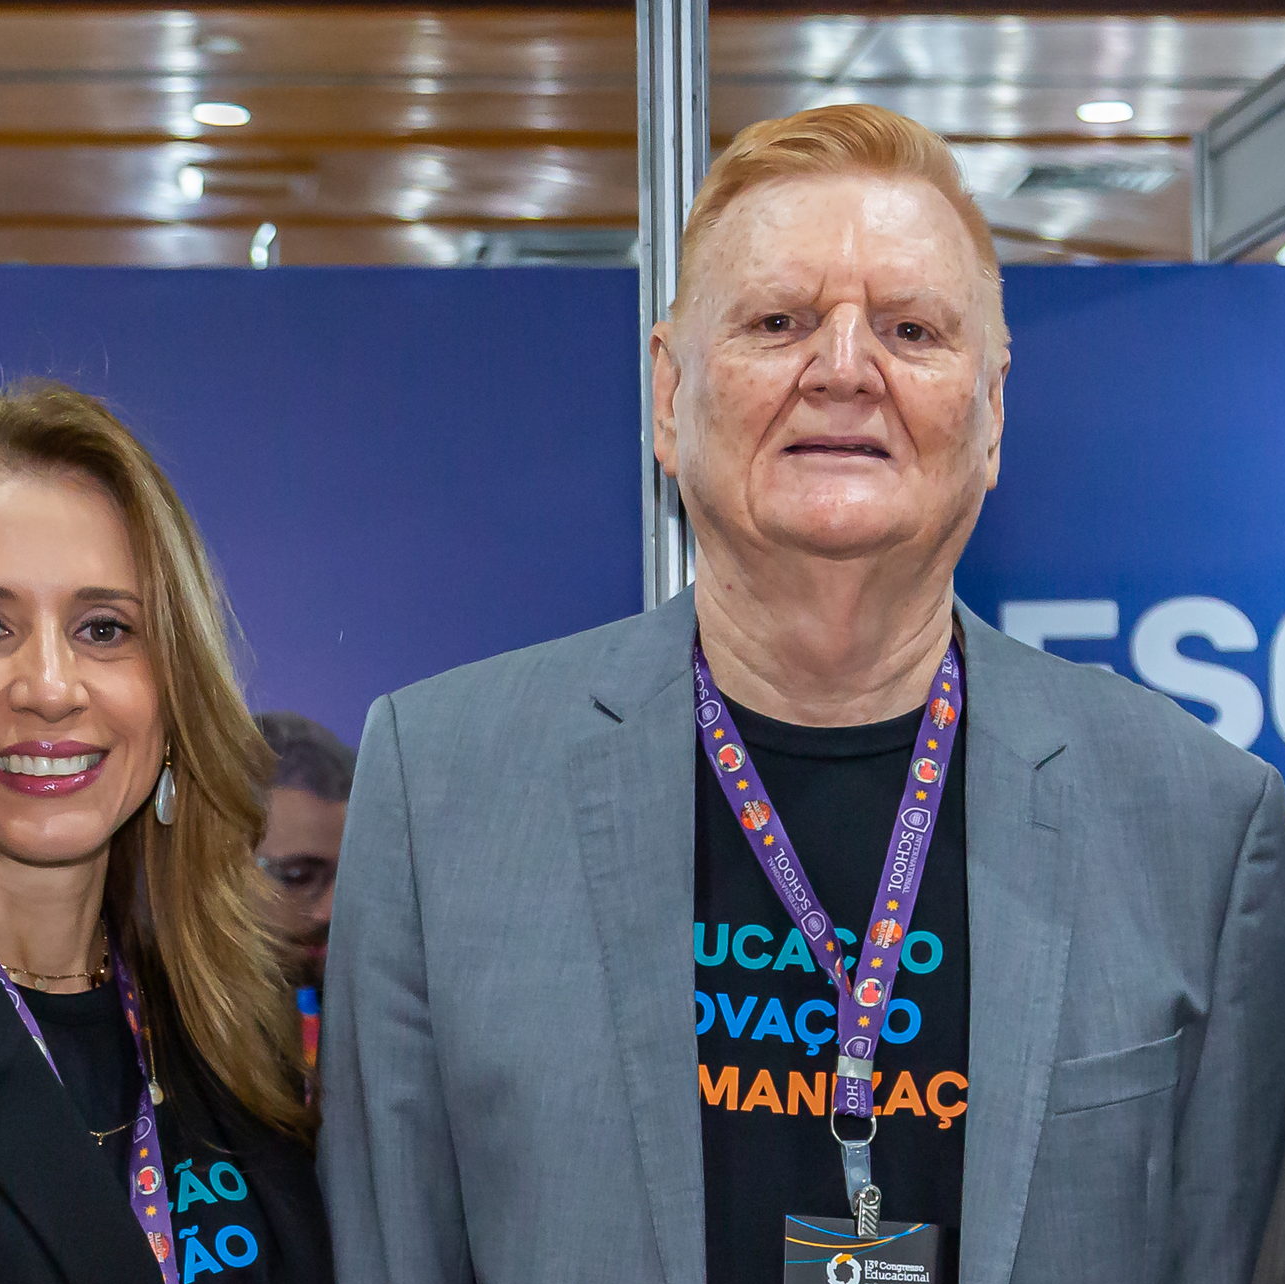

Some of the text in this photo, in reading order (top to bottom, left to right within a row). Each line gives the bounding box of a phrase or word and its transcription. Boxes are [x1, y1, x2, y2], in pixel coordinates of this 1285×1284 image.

[767, 856, 803, 917] INTERNATIONAL
[775, 847, 812, 911] SCHOOL
[888, 831, 915, 892] SCHOOL
[902, 834, 924, 894] INTERNATIONAL
[694, 923, 944, 985] UCAO
[695, 990, 922, 1056] OVAÇO
[698, 1063, 967, 1129] MANAÇ
[167, 1158, 248, 1213] ÃO
[176, 1224, 259, 1284] ÃO
[864, 1269, 930, 1283] Educacional
[879, 1263, 925, 1273] Congresso
